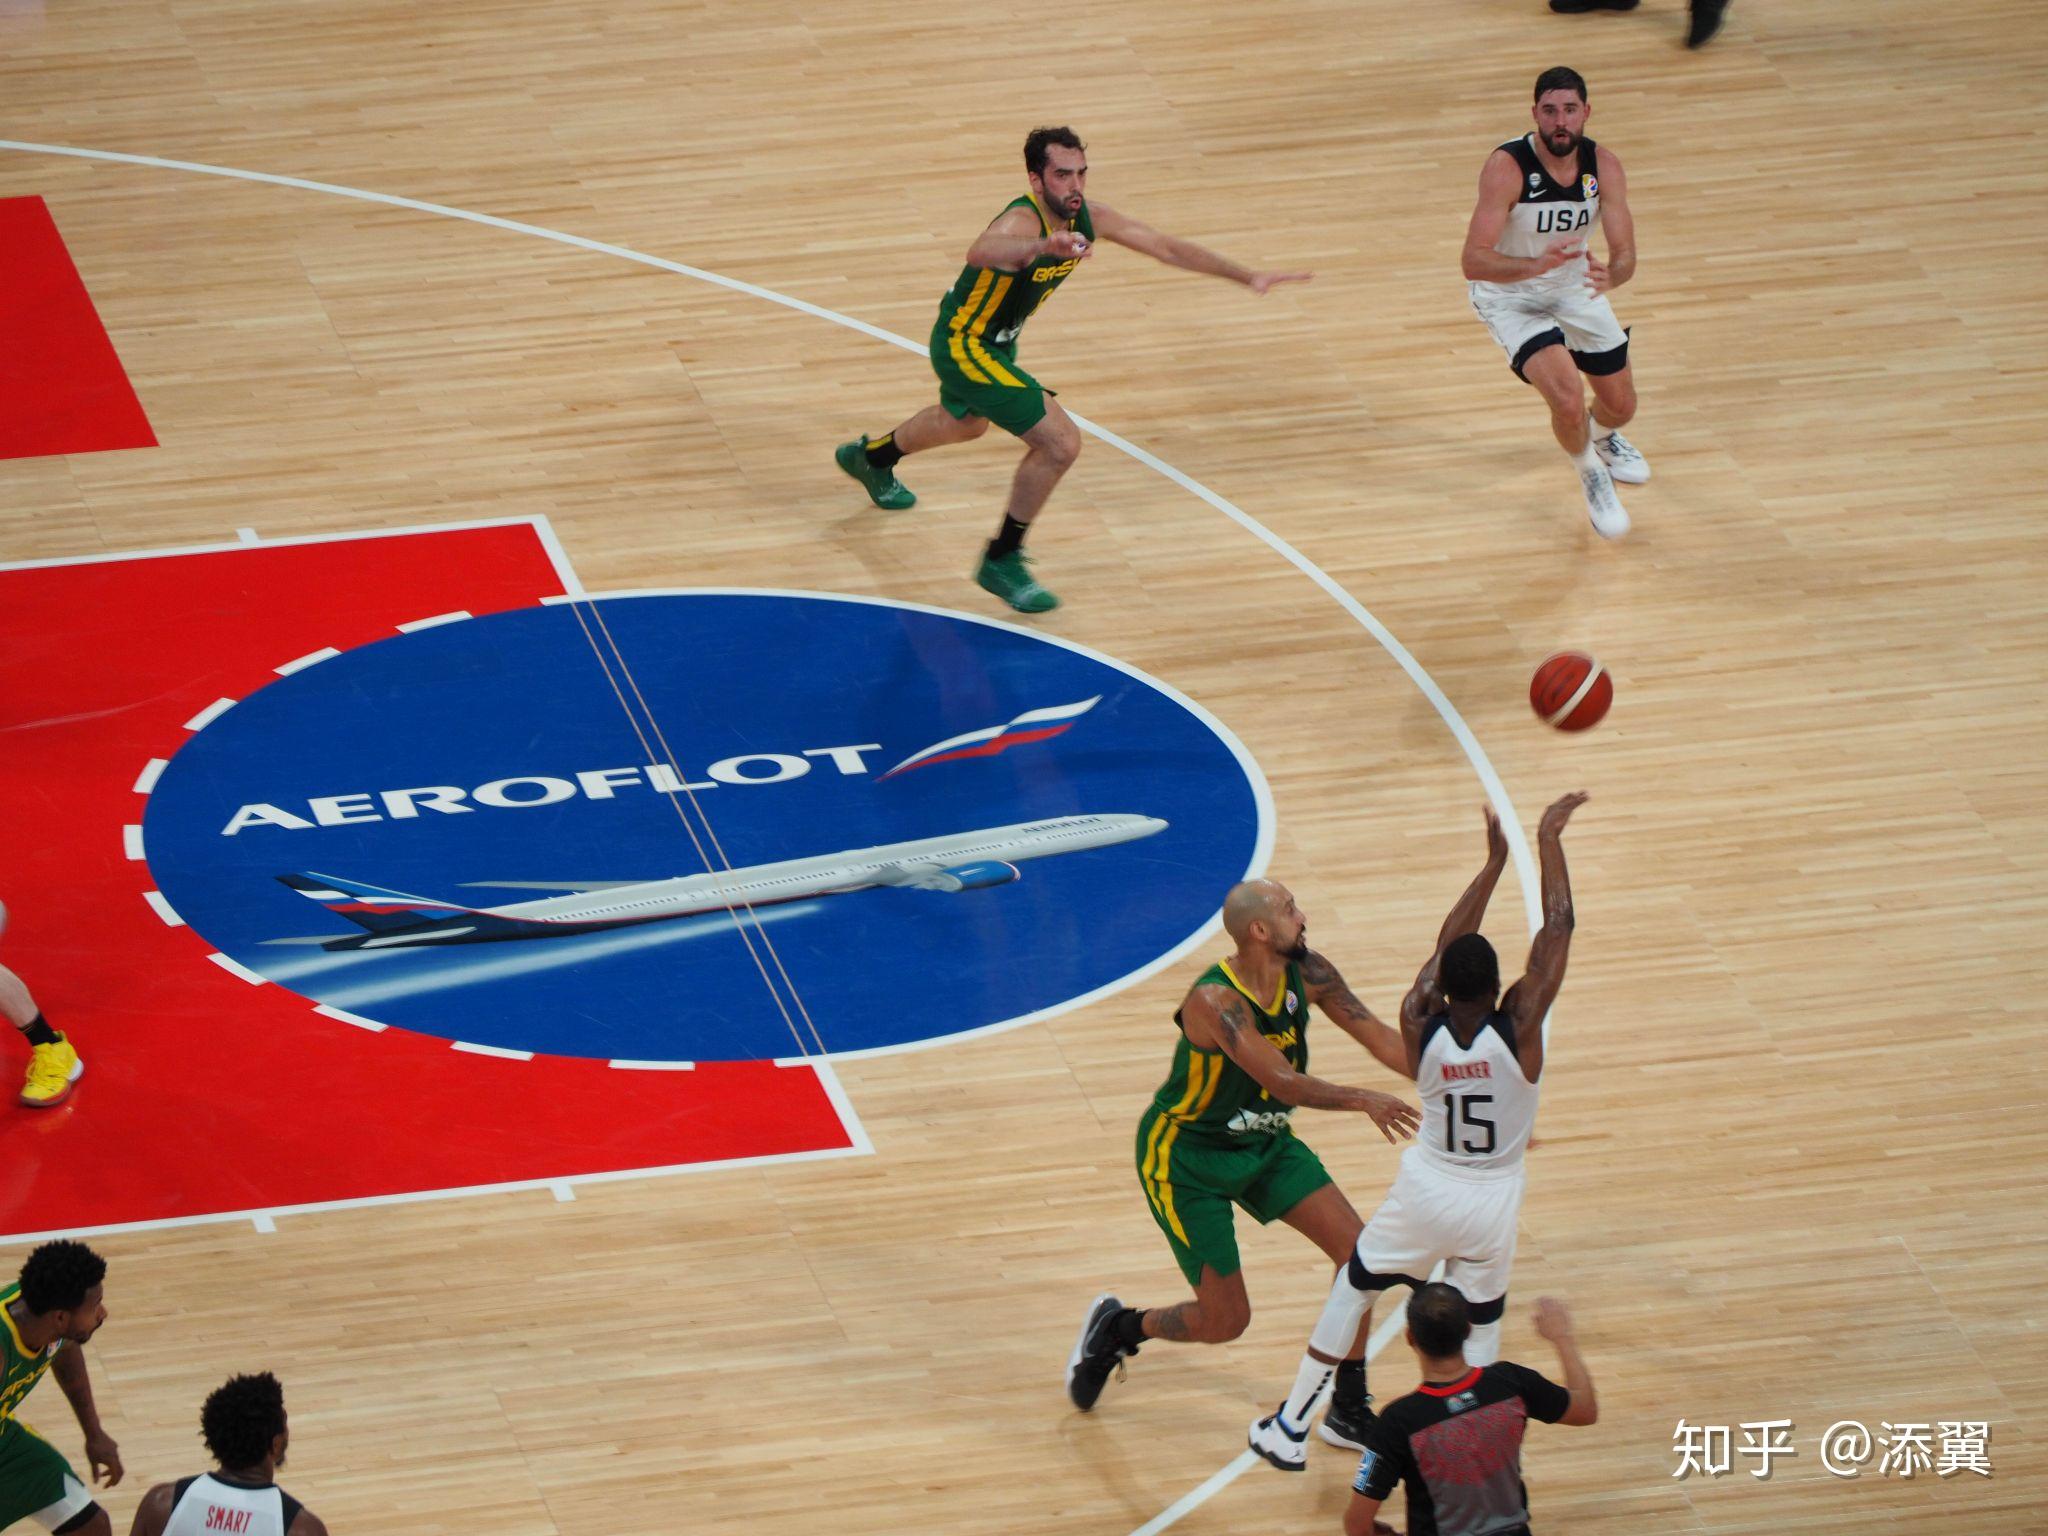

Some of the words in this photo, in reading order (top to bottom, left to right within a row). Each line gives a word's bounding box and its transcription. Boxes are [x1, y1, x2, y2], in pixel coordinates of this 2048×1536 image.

[1537, 209, 1590, 233] USA
[220, 743, 882, 837] AEROFLOT
[1444, 1093, 1496, 1154] 15
[206, 1505, 252, 1533] SMART
